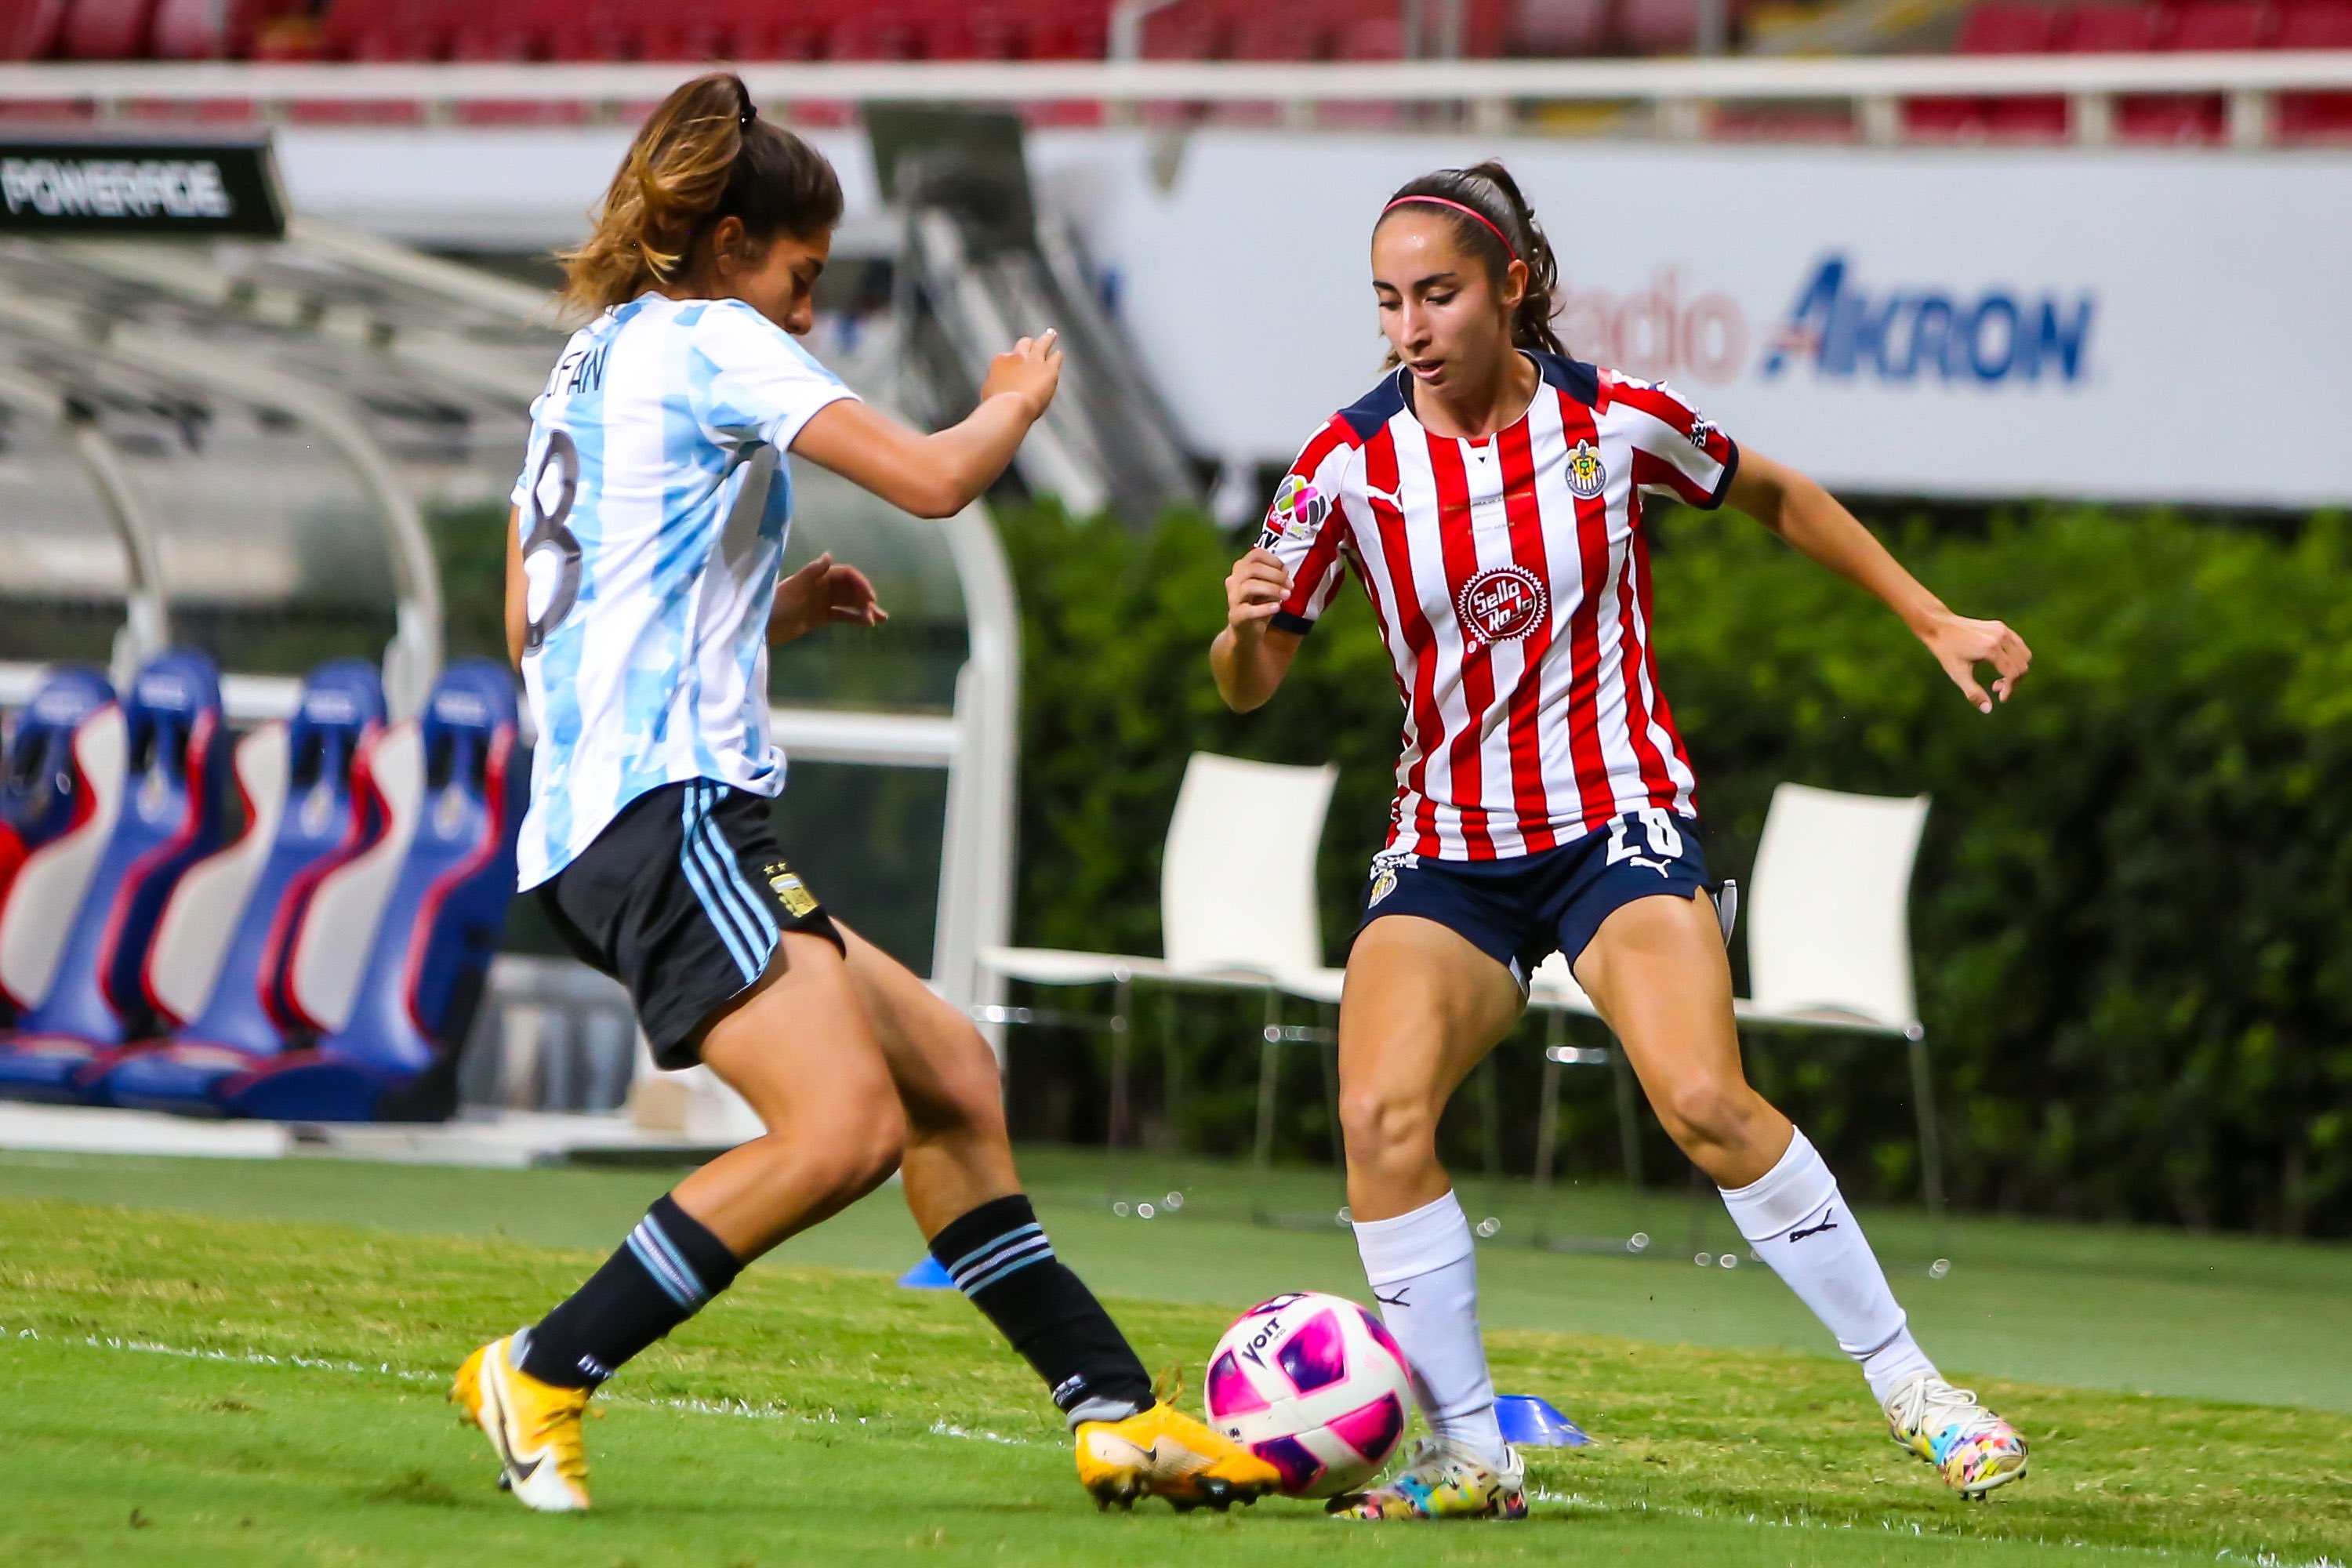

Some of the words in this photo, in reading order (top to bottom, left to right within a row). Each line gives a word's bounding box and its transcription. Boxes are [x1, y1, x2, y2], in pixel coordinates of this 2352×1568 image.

[1762, 254, 2095, 384] AKRON
[546, 342, 610, 397] FAN
[1473, 579, 1521, 615] Sello
[1241, 1316, 1280, 1370] VOIT
